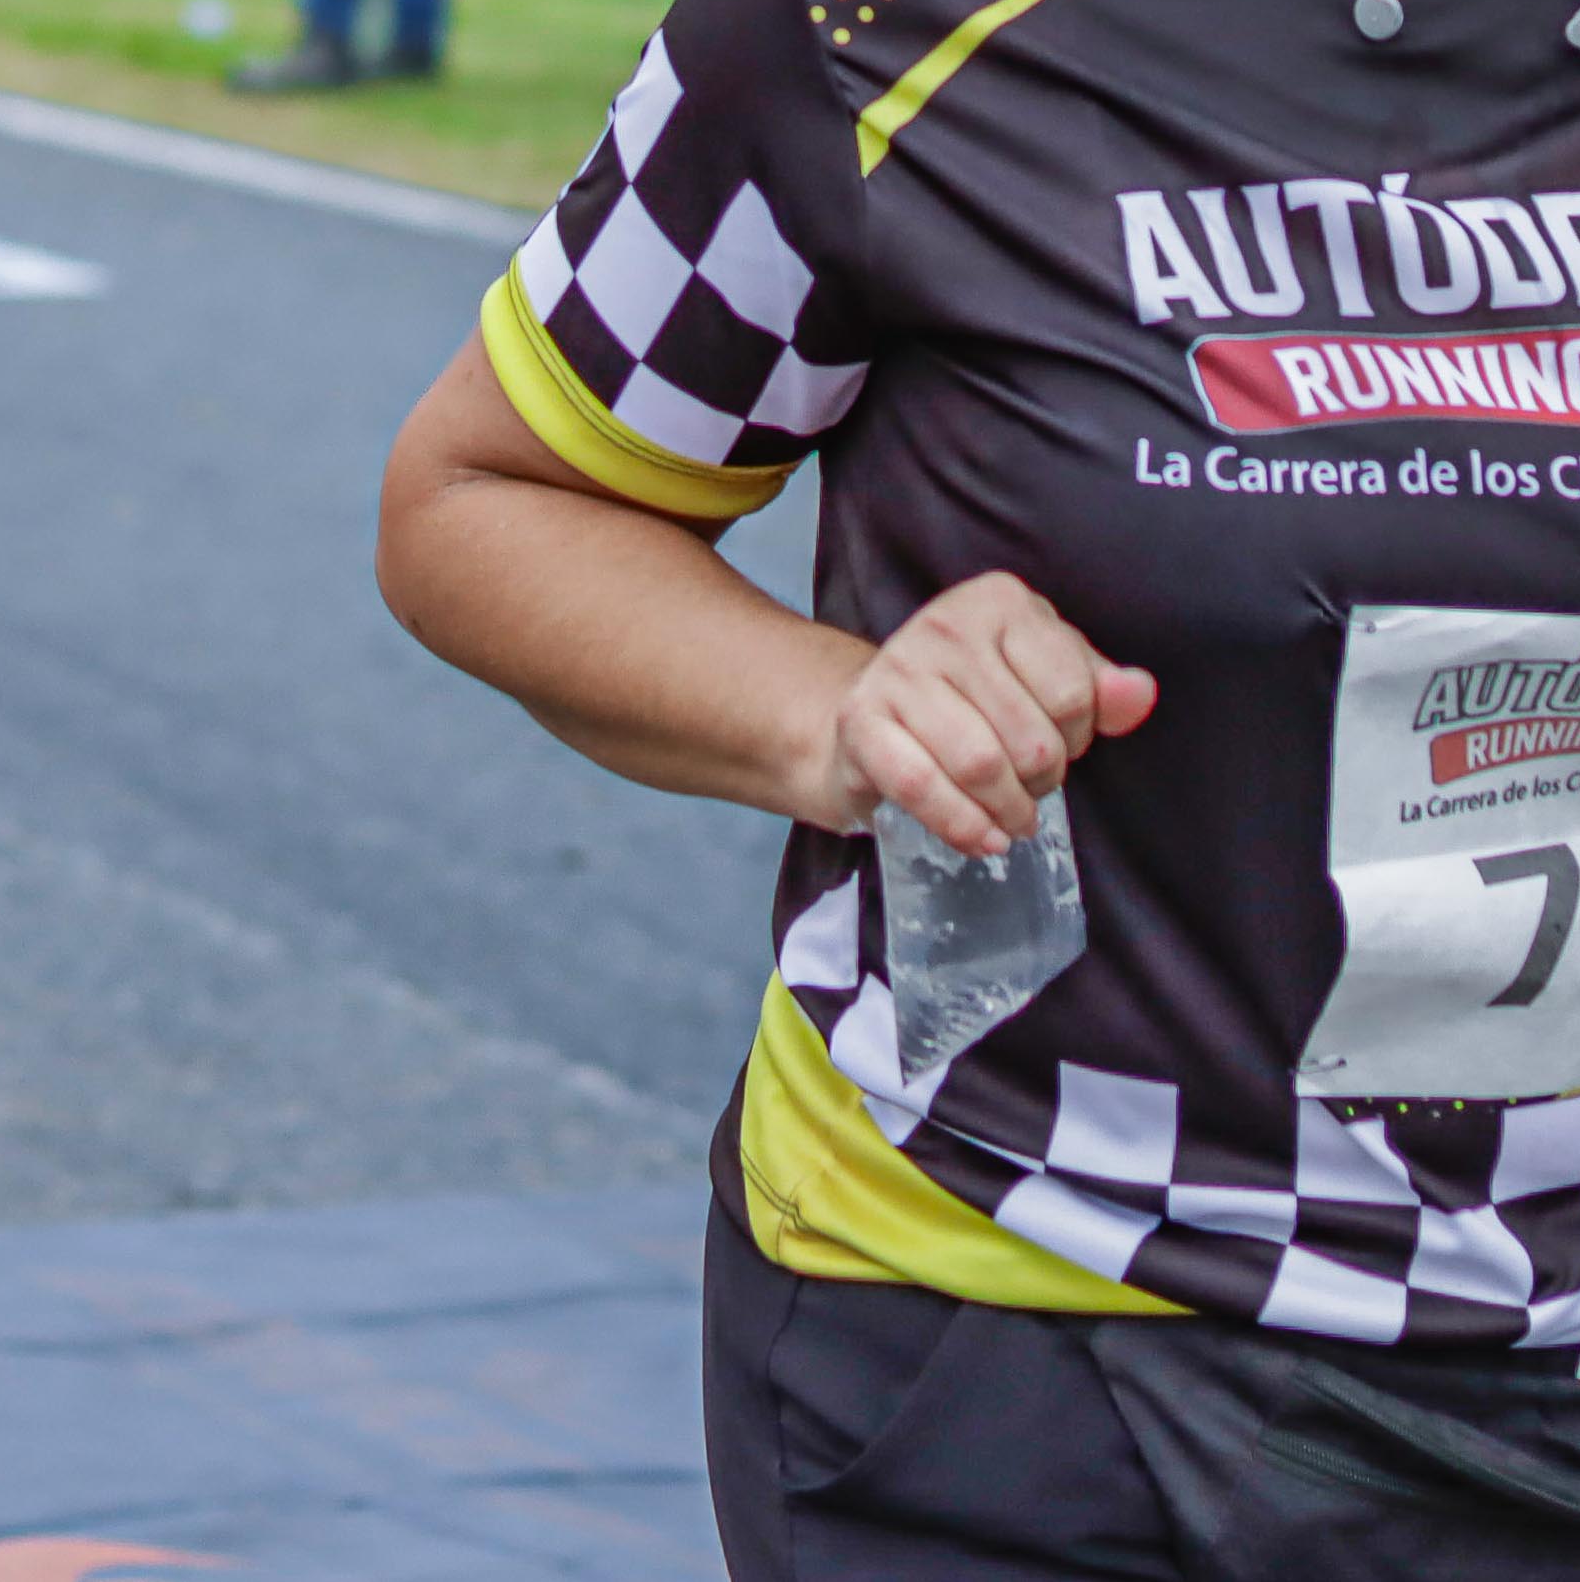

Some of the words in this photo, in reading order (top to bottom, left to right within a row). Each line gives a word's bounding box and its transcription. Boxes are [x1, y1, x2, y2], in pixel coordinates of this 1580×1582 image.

[1135, 437, 1191, 488] La
[1204, 446, 1387, 495] Carrera
[1398, 447, 1459, 495] de
[1469, 449, 1541, 498] los
[1399, 801, 1422, 824] La
[1426, 791, 1498, 817] Carrera
[1503, 782, 1527, 804] de
[1532, 776, 1560, 799] los
